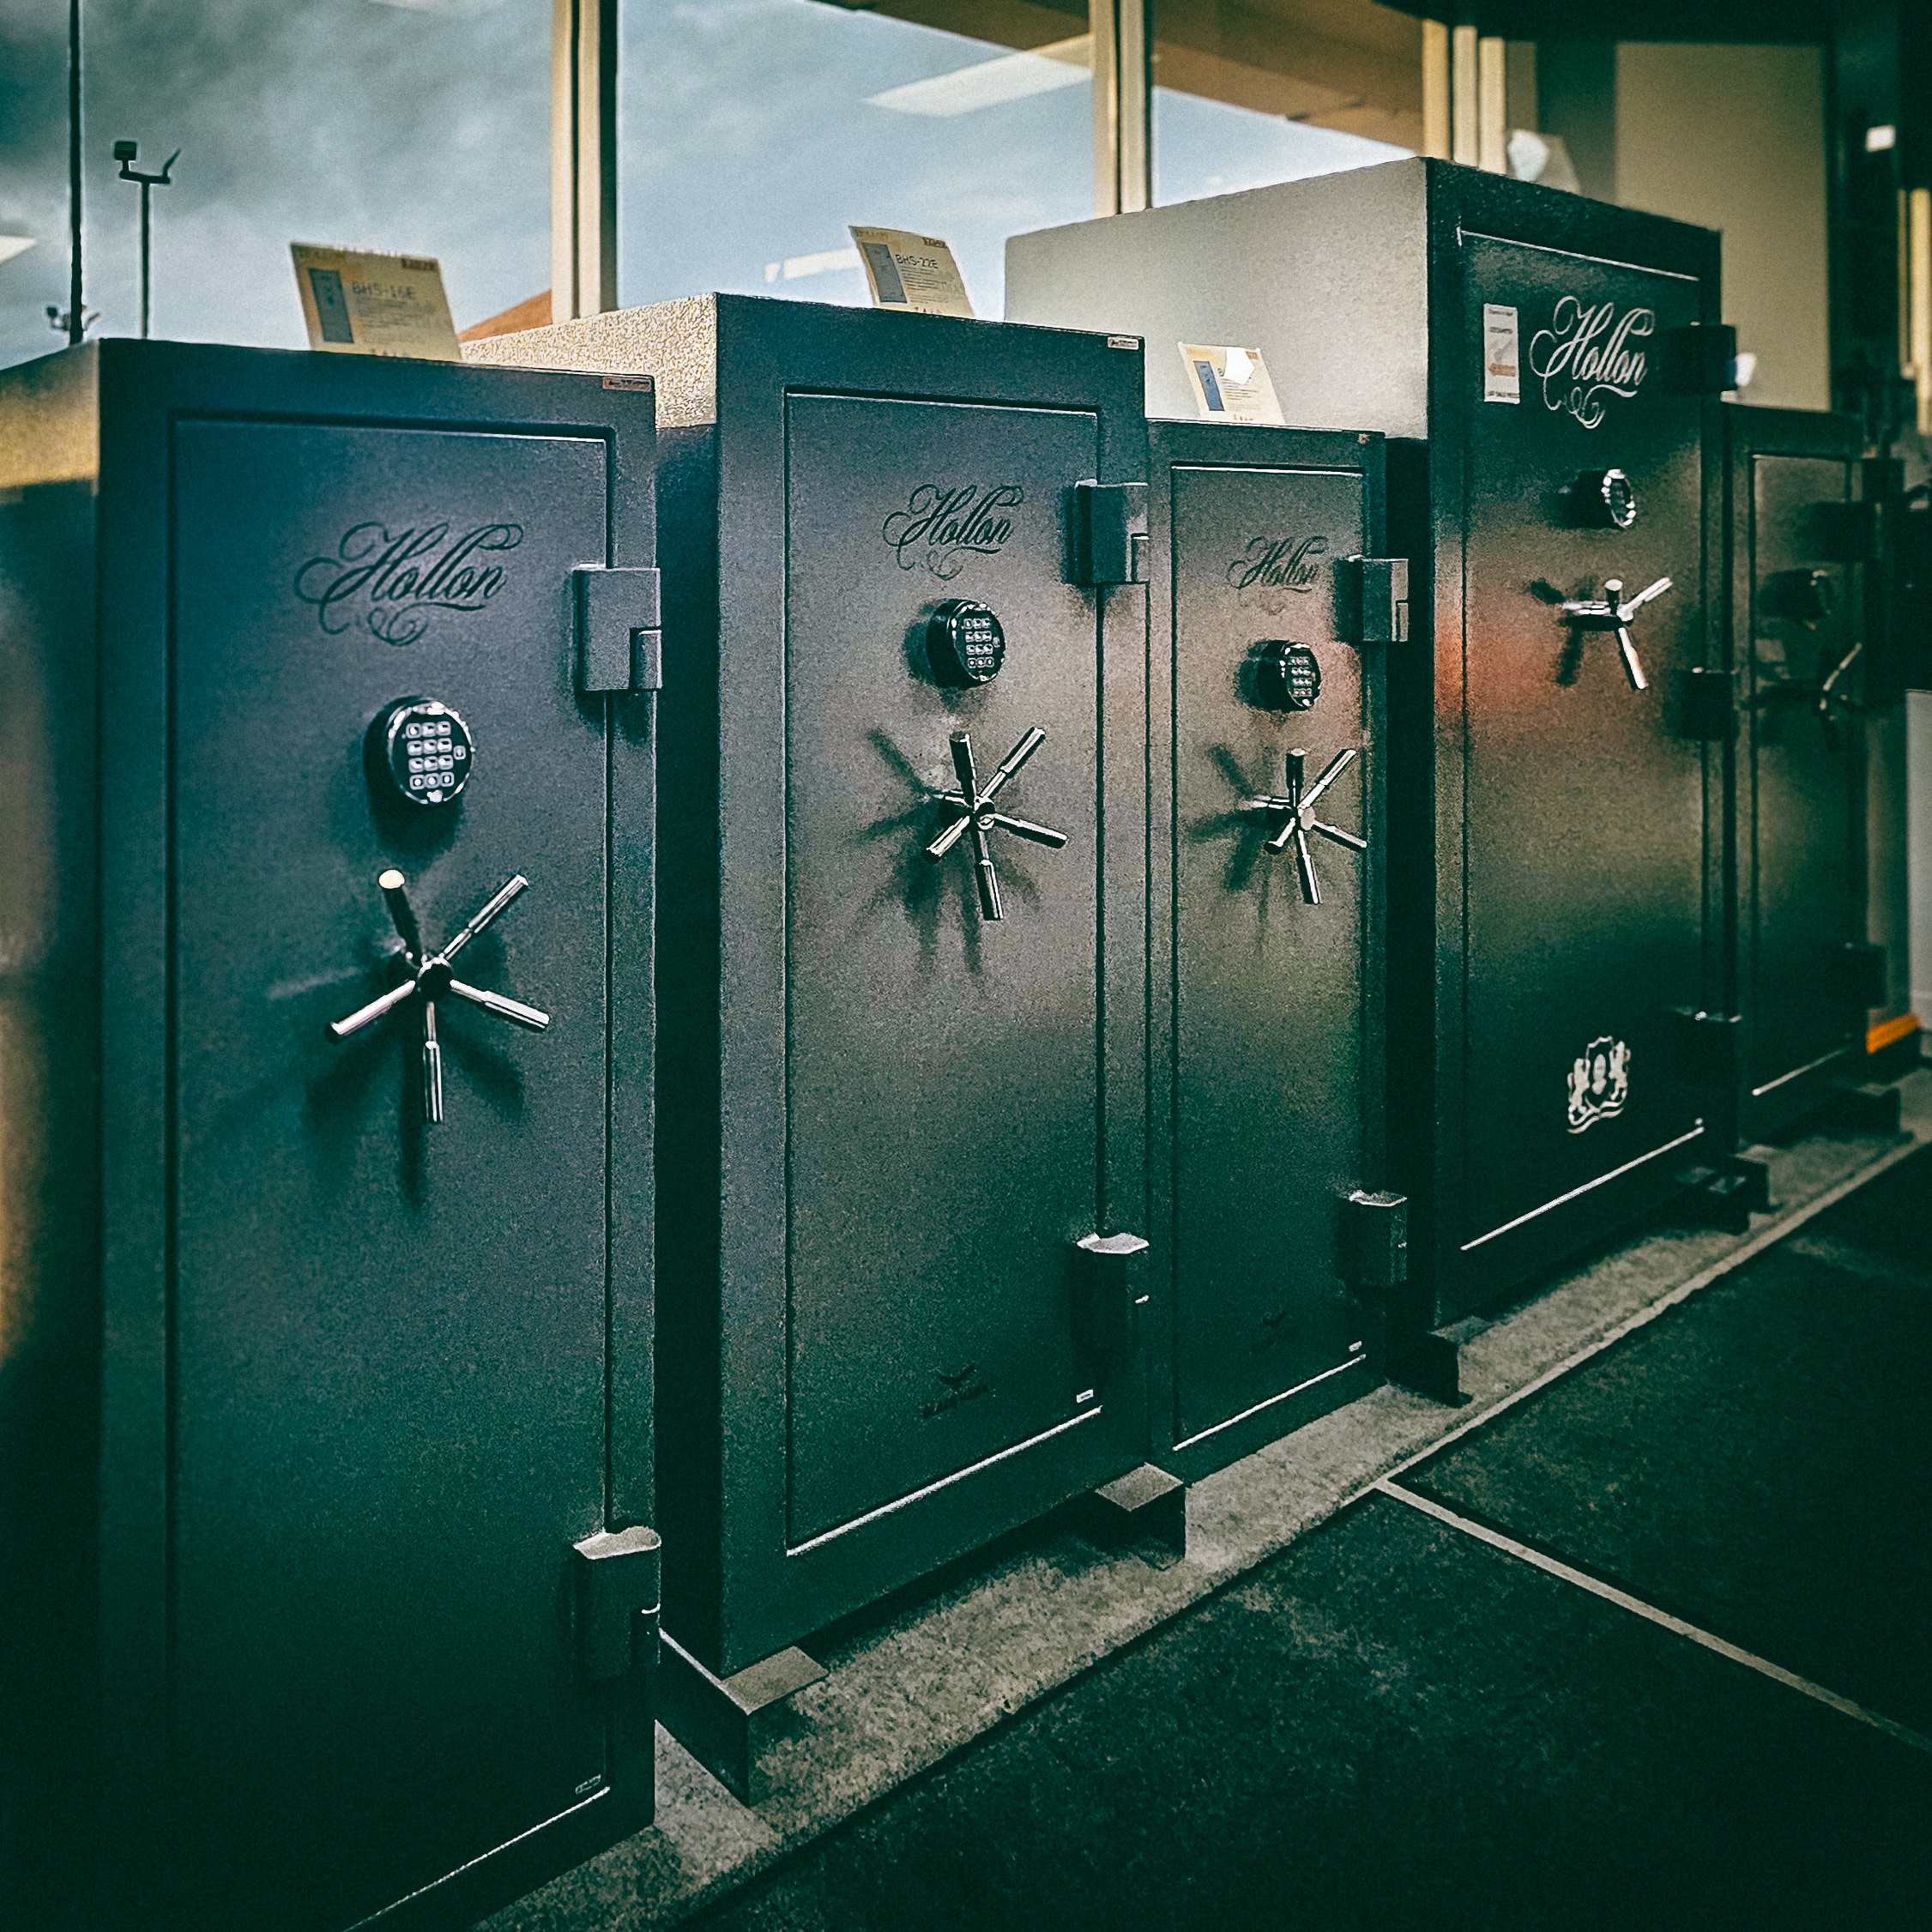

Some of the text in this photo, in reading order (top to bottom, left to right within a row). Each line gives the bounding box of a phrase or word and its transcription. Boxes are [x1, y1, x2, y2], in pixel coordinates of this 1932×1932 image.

[895, 254, 939, 269] BHS-22E
[1530, 295, 1655, 429] Hollon
[882, 483, 1024, 581] Hollon
[1227, 535, 1329, 615] Hollon
[293, 521, 524, 647] Hollon
